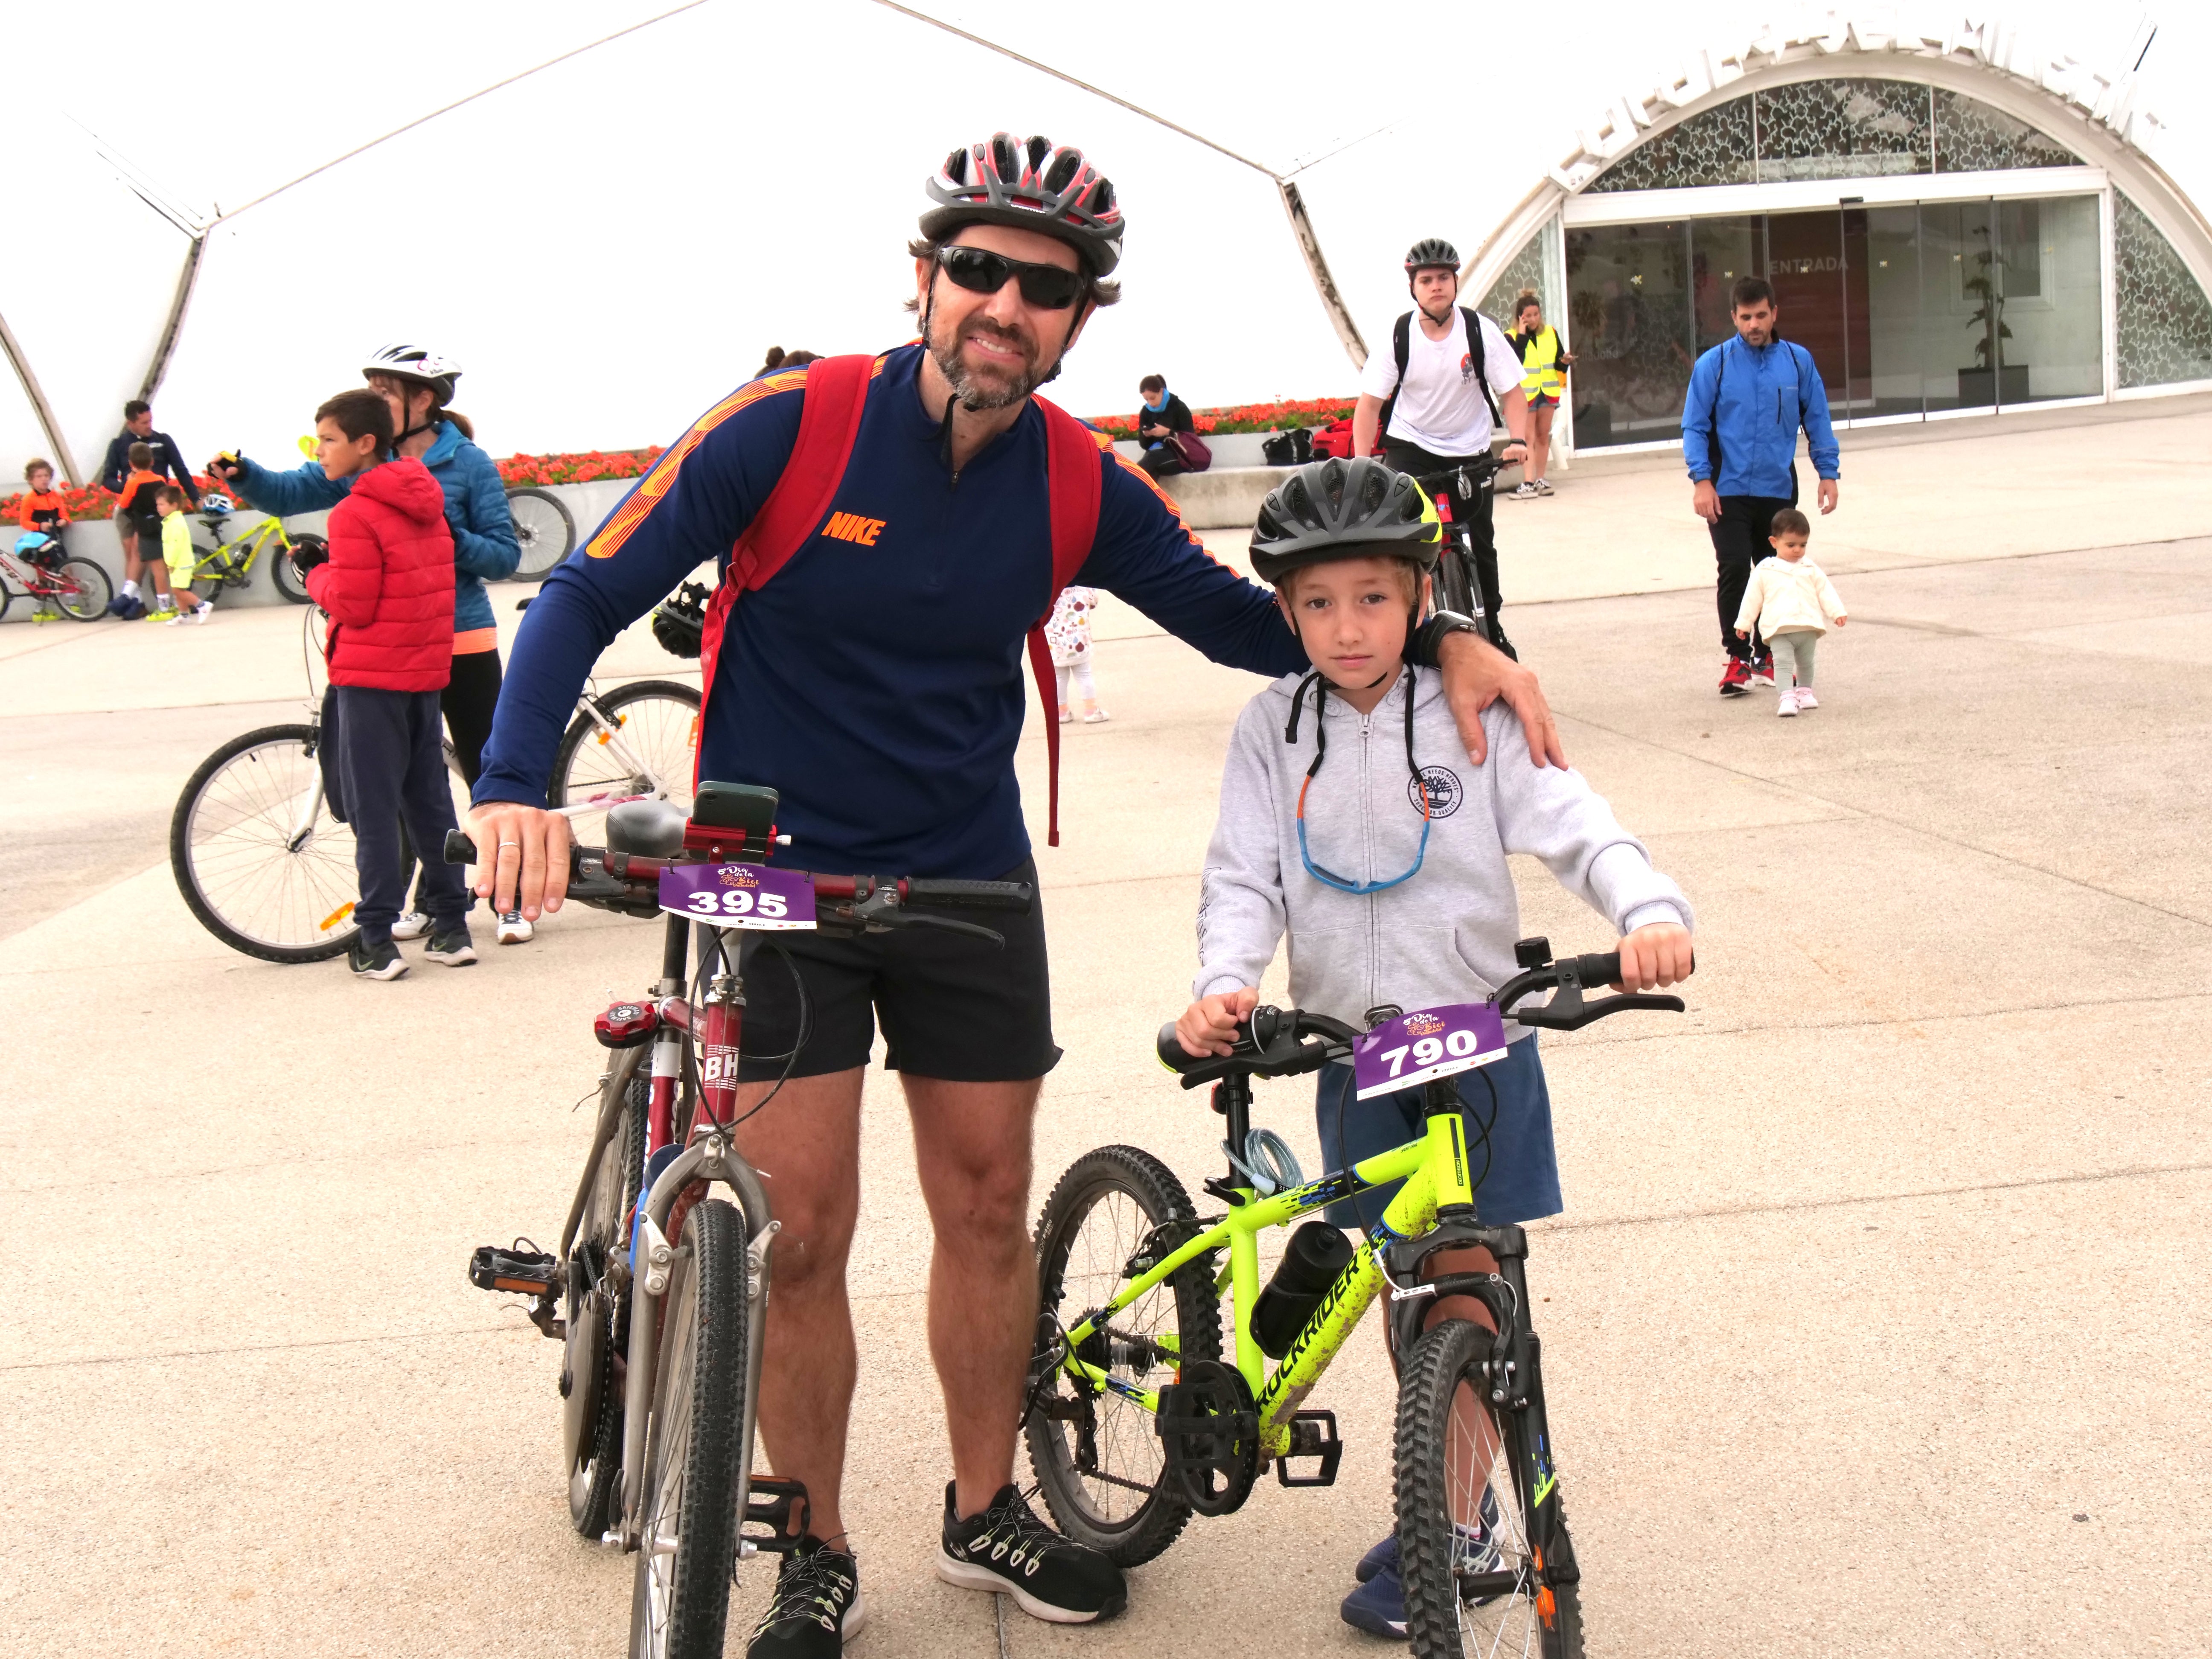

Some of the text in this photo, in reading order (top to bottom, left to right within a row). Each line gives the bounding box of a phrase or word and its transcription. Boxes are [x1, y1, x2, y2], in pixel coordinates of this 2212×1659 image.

[1770, 257, 1848, 274] ENTRADA
[821, 511, 886, 546] NIKE
[1414, 799, 1456, 815] SUPEOR QUALITY
[737, 876, 760, 885] Bici
[687, 890, 788, 917] 395
[1424, 1021, 1446, 1031] Bici
[704, 1053, 738, 1081] BH
[1380, 1030, 1477, 1077] 790
[1256, 1252, 1360, 1415] ROCKRIDER
